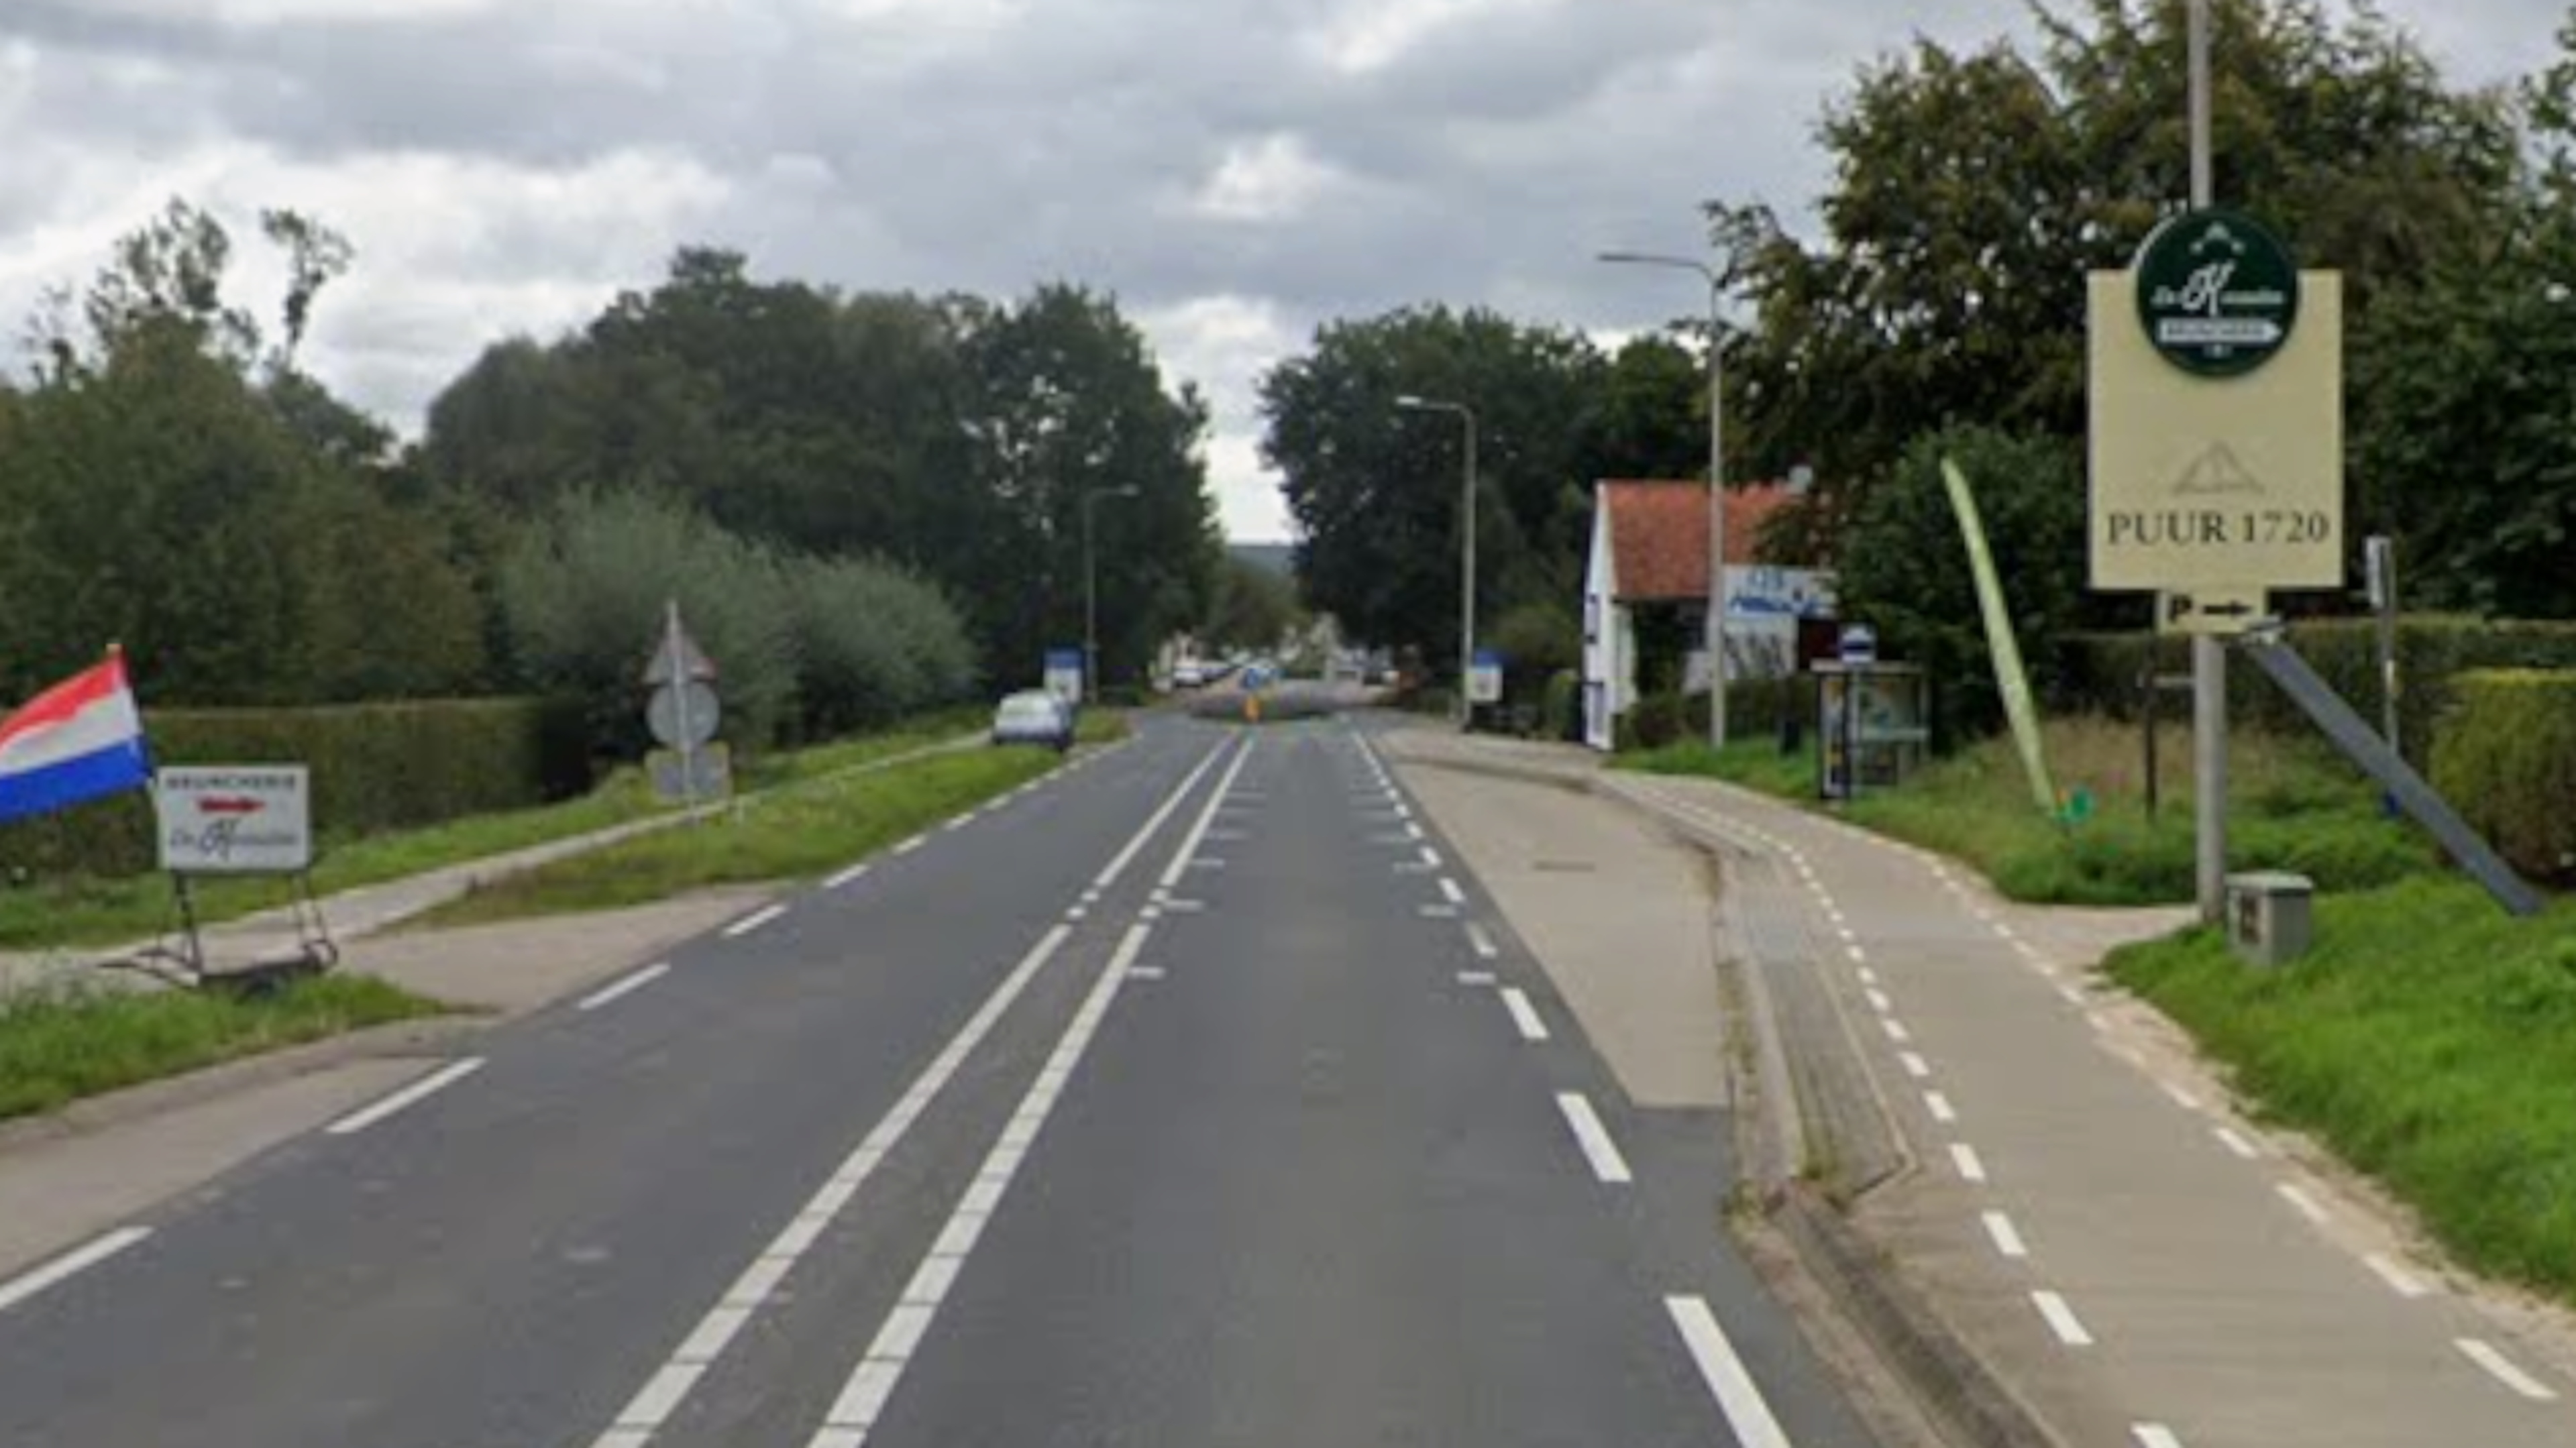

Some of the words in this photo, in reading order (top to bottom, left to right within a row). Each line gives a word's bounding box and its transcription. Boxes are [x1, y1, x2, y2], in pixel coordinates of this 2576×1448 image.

[2108, 510, 2227, 546] PUUR
[2243, 510, 2330, 544] 1720
[2168, 594, 2194, 624] P
